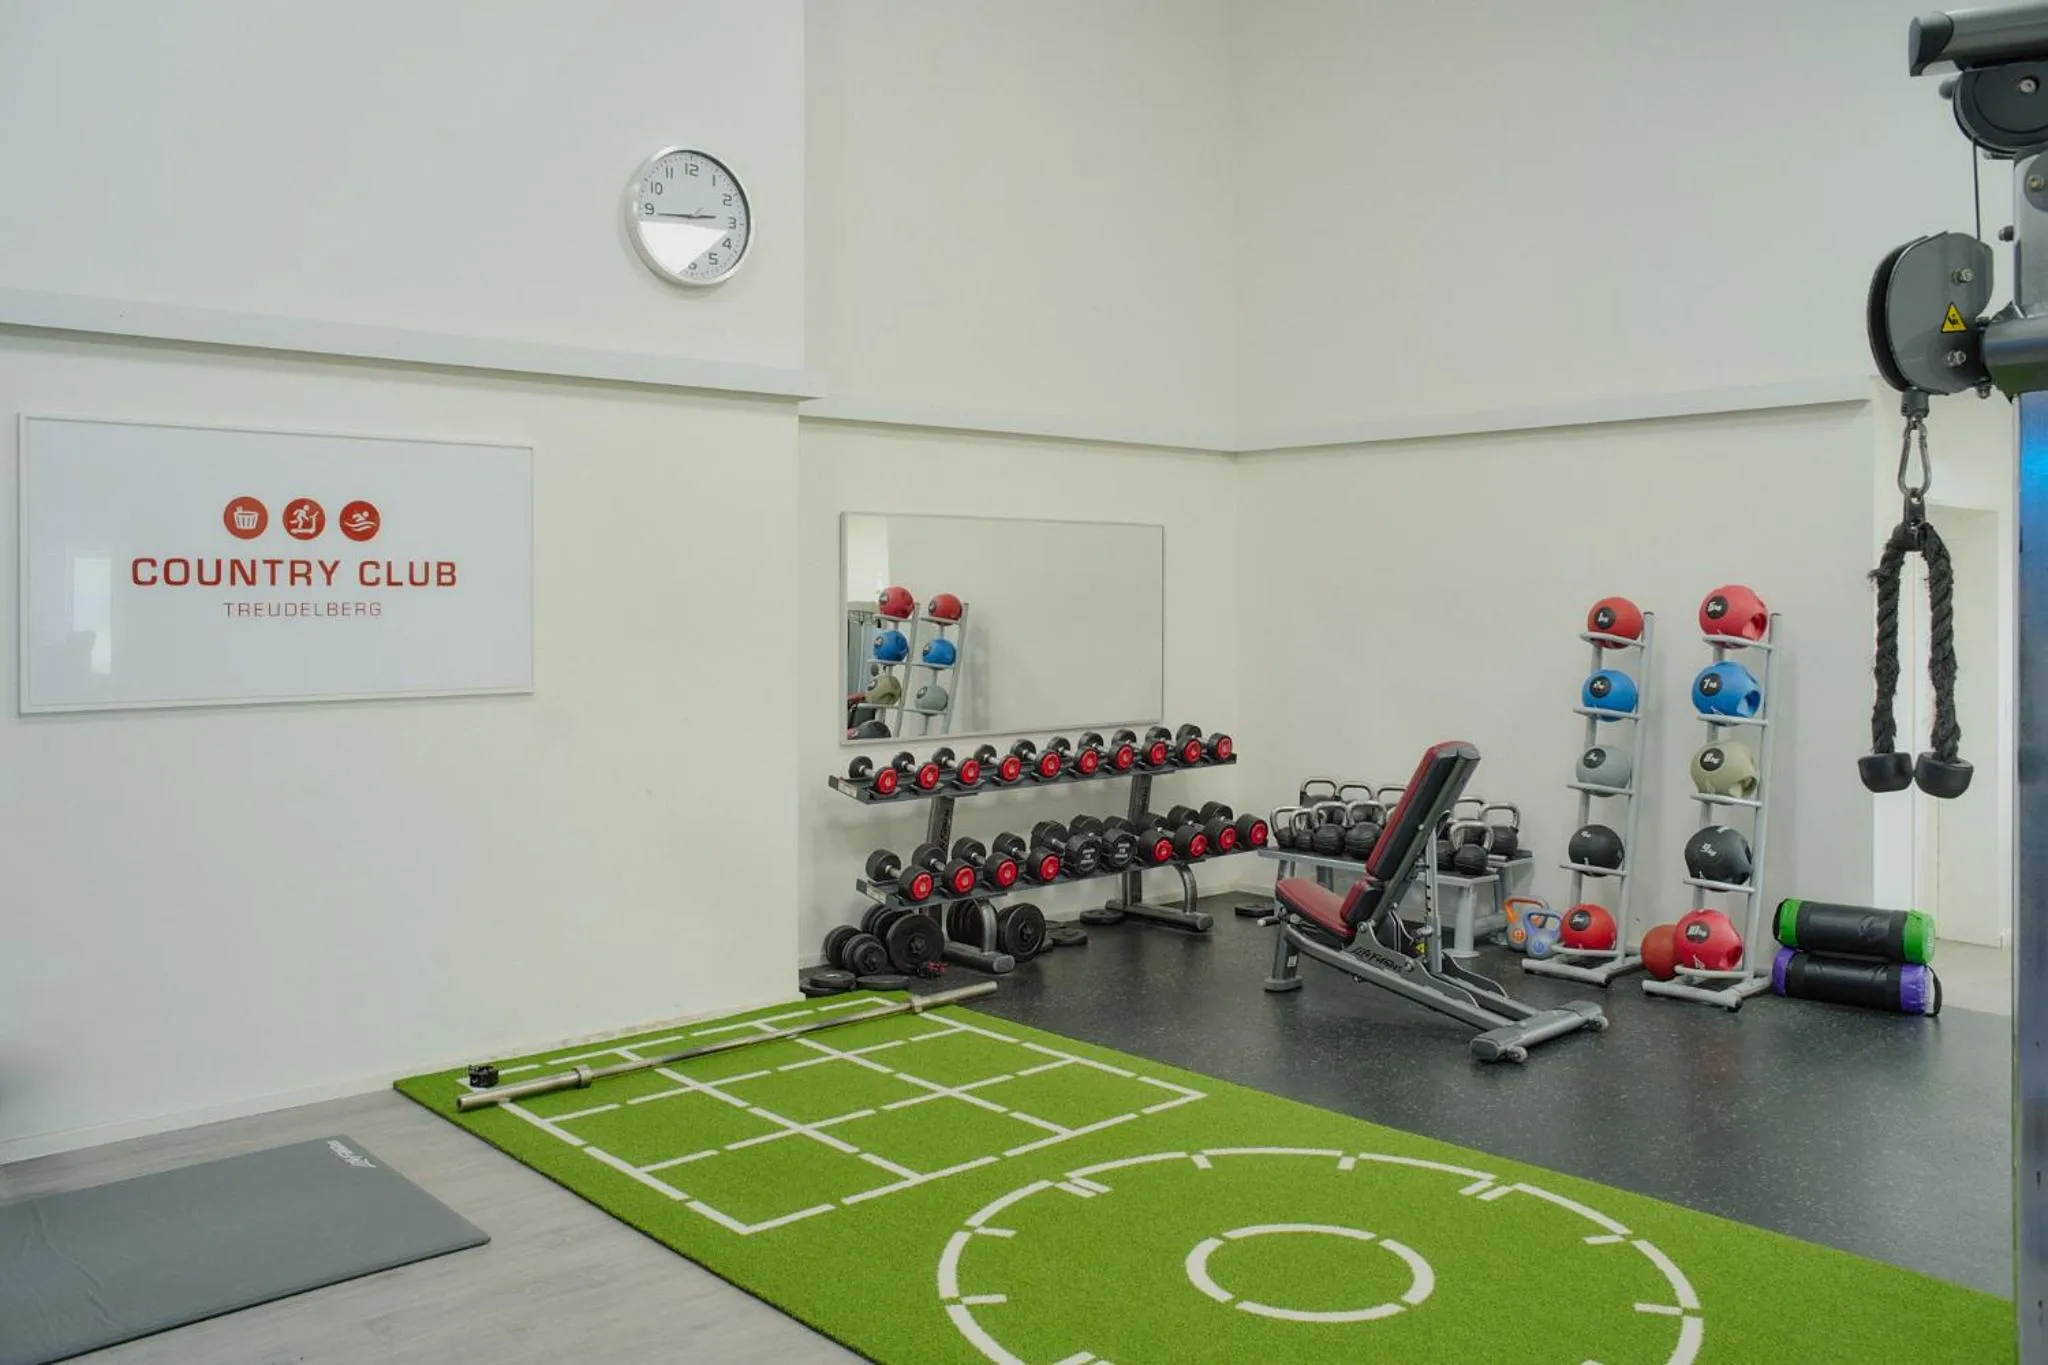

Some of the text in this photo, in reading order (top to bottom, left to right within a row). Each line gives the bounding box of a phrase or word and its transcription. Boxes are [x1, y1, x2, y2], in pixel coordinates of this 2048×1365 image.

[665, 165, 674, 180] 11
[684, 162, 699, 177] 12
[650, 181, 664, 195] 10
[722, 193, 733, 207] 2
[644, 202, 655, 216] 9
[728, 216, 737, 230] 3
[722, 238, 733, 250] 4
[708, 252, 720, 266] 5
[131, 556, 457, 589] COUNTRY CLUB
[223, 601, 382, 617] TREUDELBERG
